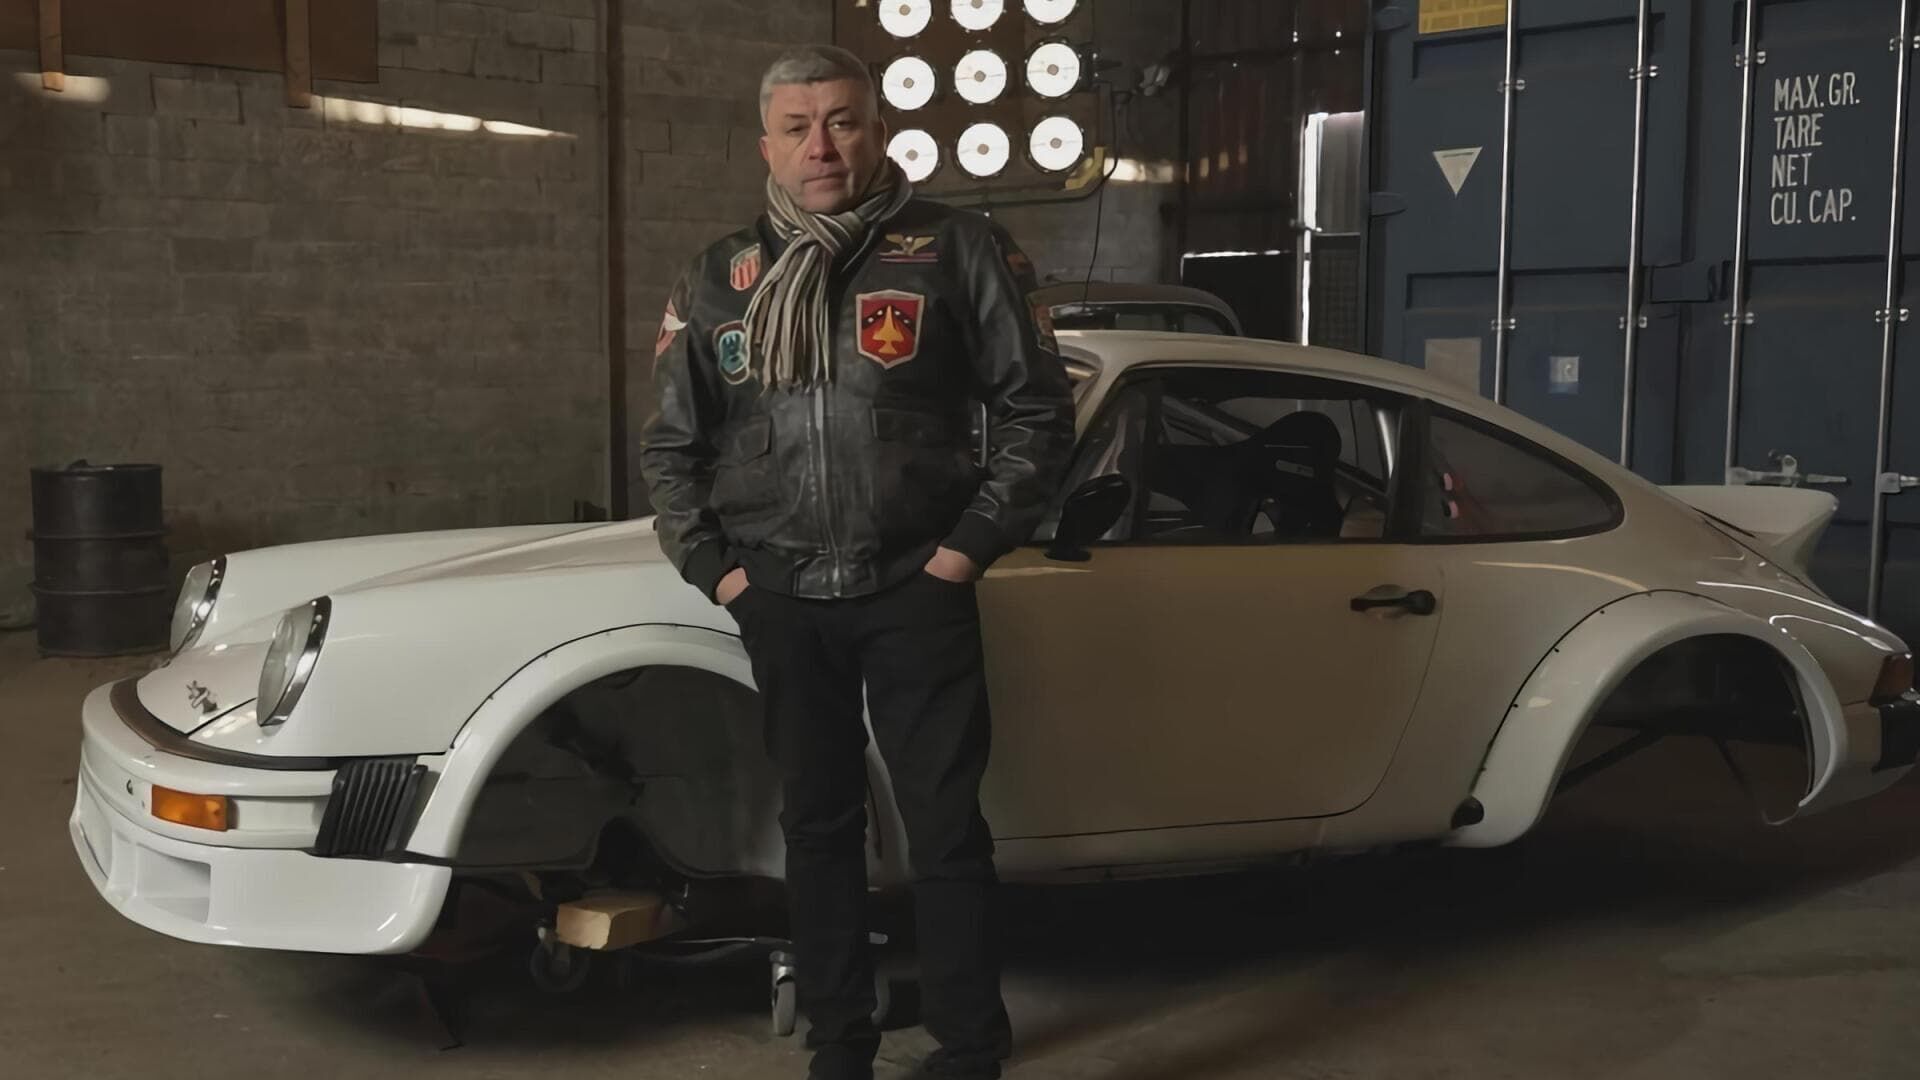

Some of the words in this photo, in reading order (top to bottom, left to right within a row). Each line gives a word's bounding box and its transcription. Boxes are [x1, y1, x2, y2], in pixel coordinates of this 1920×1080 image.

[1774, 113, 1824, 150] TARE
[1771, 152, 1813, 188] NET
[1771, 191, 1802, 225] CU.
[1808, 188, 1856, 223] CAP.
